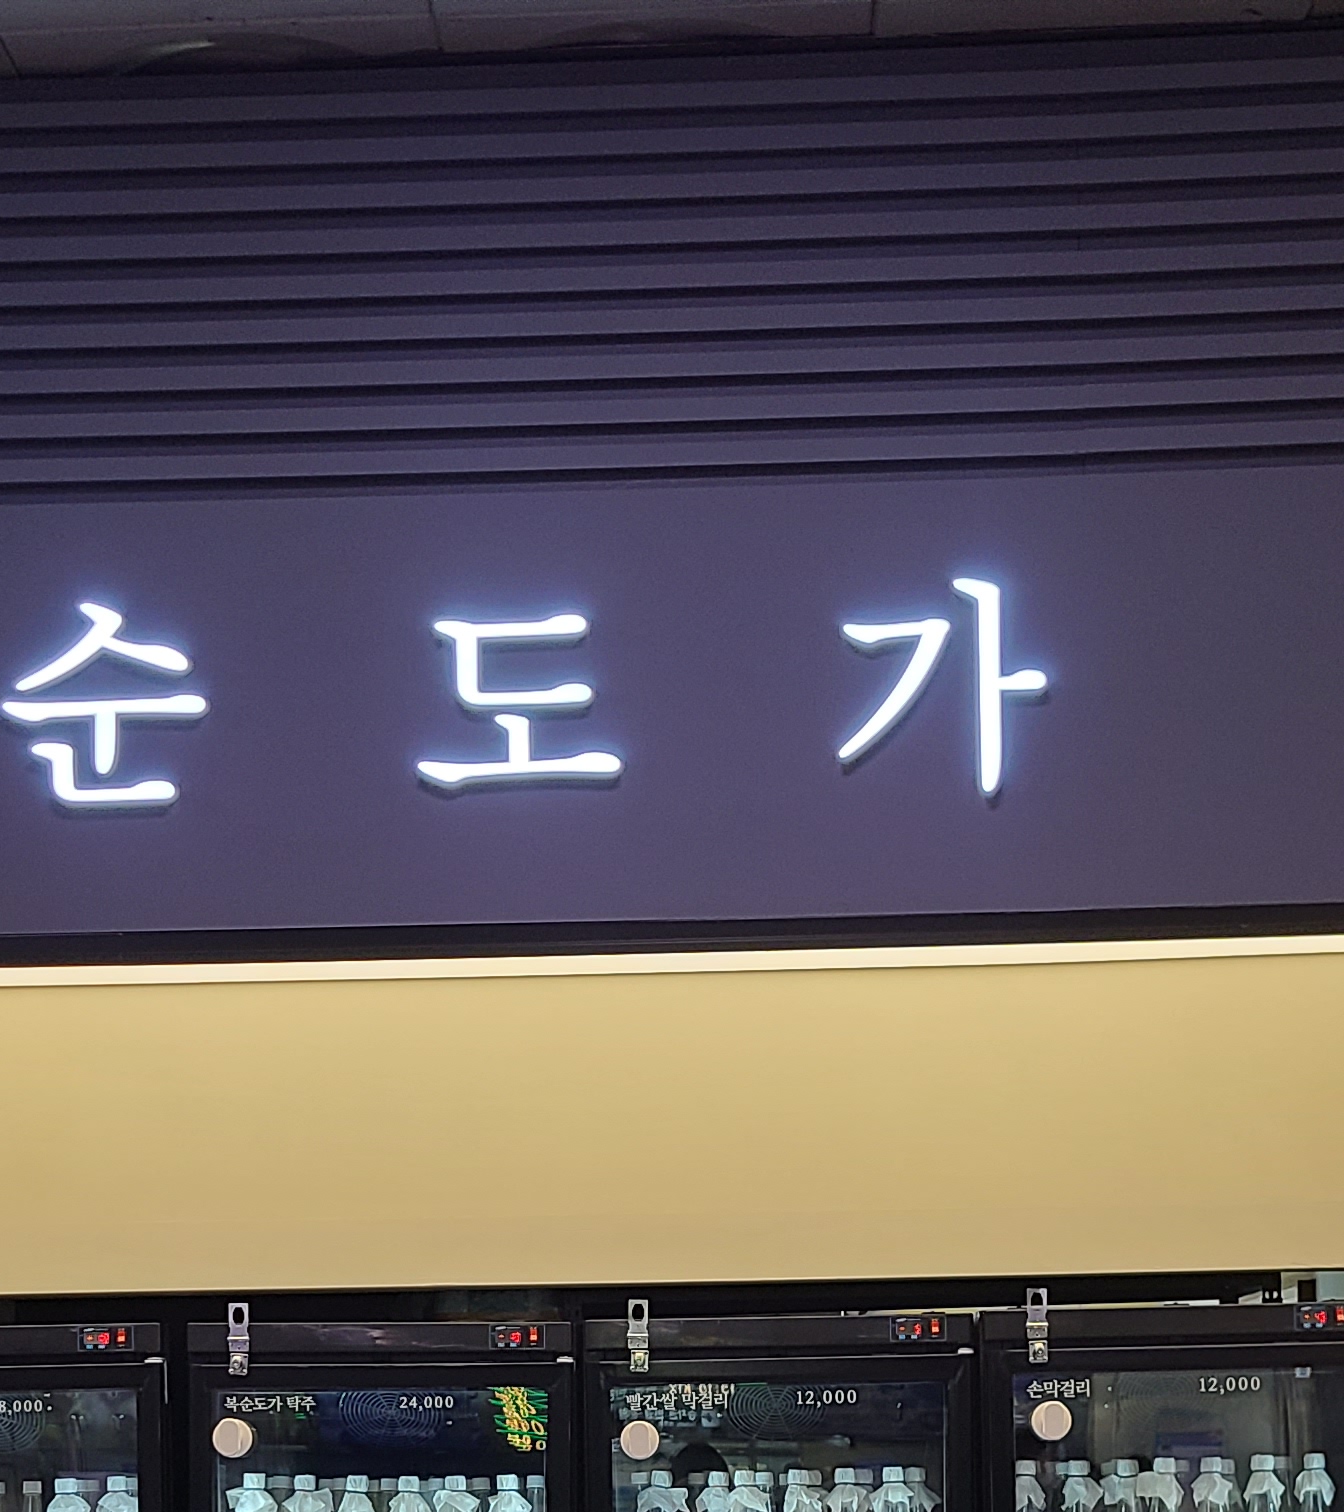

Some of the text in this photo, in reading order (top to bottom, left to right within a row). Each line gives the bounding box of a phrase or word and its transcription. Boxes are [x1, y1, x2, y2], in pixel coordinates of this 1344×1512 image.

[1026, 1376, 1261, 1398] 손막걸리 12,000
[224, 1395, 454, 1412] 복순도가 탁주 24,000
[625, 1390, 857, 1411] 빨간쌀 막걸리 12,000
